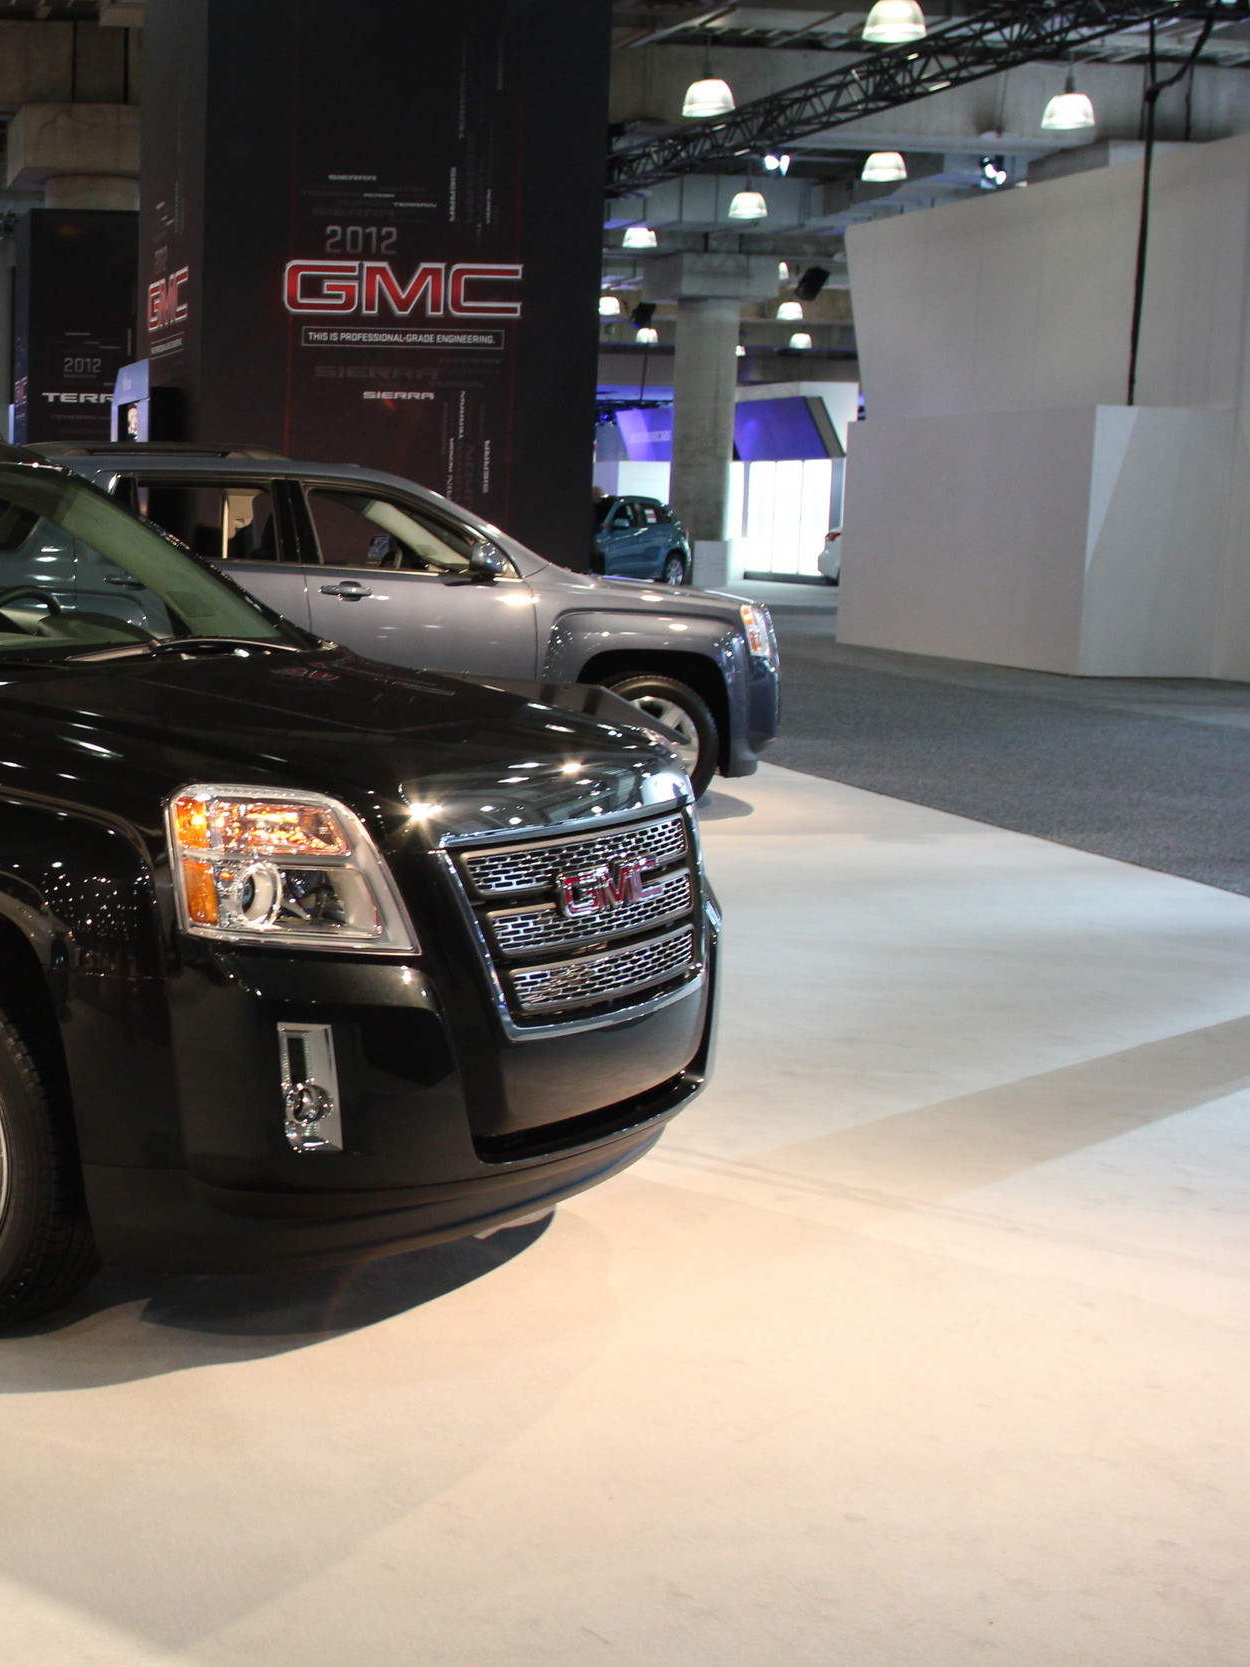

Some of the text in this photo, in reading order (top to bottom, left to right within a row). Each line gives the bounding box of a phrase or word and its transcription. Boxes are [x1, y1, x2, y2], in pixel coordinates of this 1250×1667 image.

[325, 225, 398, 255] 2012
[148, 265, 189, 332] GMC
[283, 259, 524, 318] GMC
[308, 331, 329, 342] THIS
[329, 332, 338, 342] IS
[340, 332, 435, 343] PROFESSIONAL-GRADE
[63, 357, 102, 373] 2012
[362, 390, 435, 400] SIERRA
[458, 391, 466, 440] TERRAIN
[482, 440, 491, 493] SIERRA
[556, 856, 664, 918] GMC
